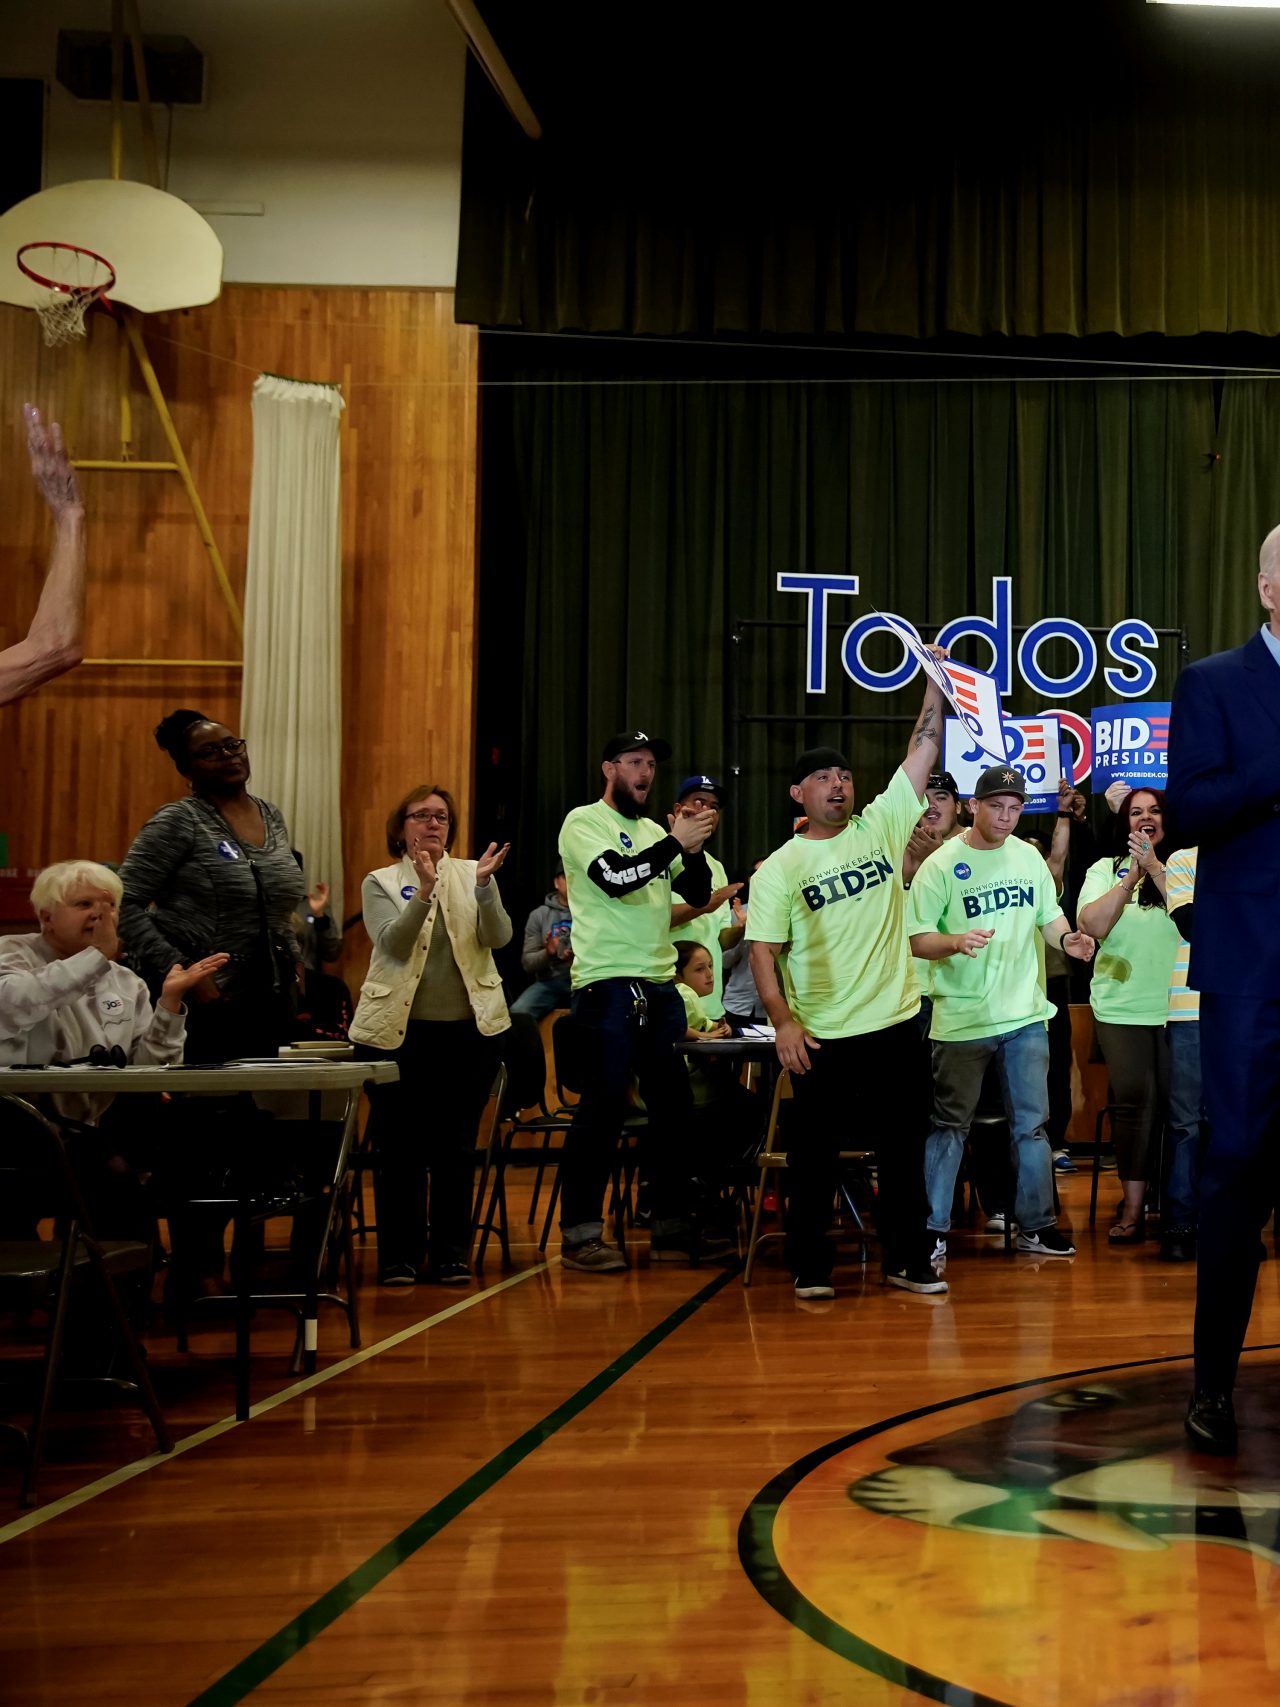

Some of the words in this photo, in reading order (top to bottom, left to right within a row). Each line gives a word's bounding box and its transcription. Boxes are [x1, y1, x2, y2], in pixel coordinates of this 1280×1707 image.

[777, 572, 1159, 698] Todos
[1095, 717, 1169, 753] BIDE
[1095, 751, 1168, 768] PRESIDE
[798, 856, 869, 888] IRONWORKERS
[801, 854, 894, 912] BIDEN
[960, 879, 1018, 897] IRONWORKERS
[962, 886, 1034, 919] BIDEN
